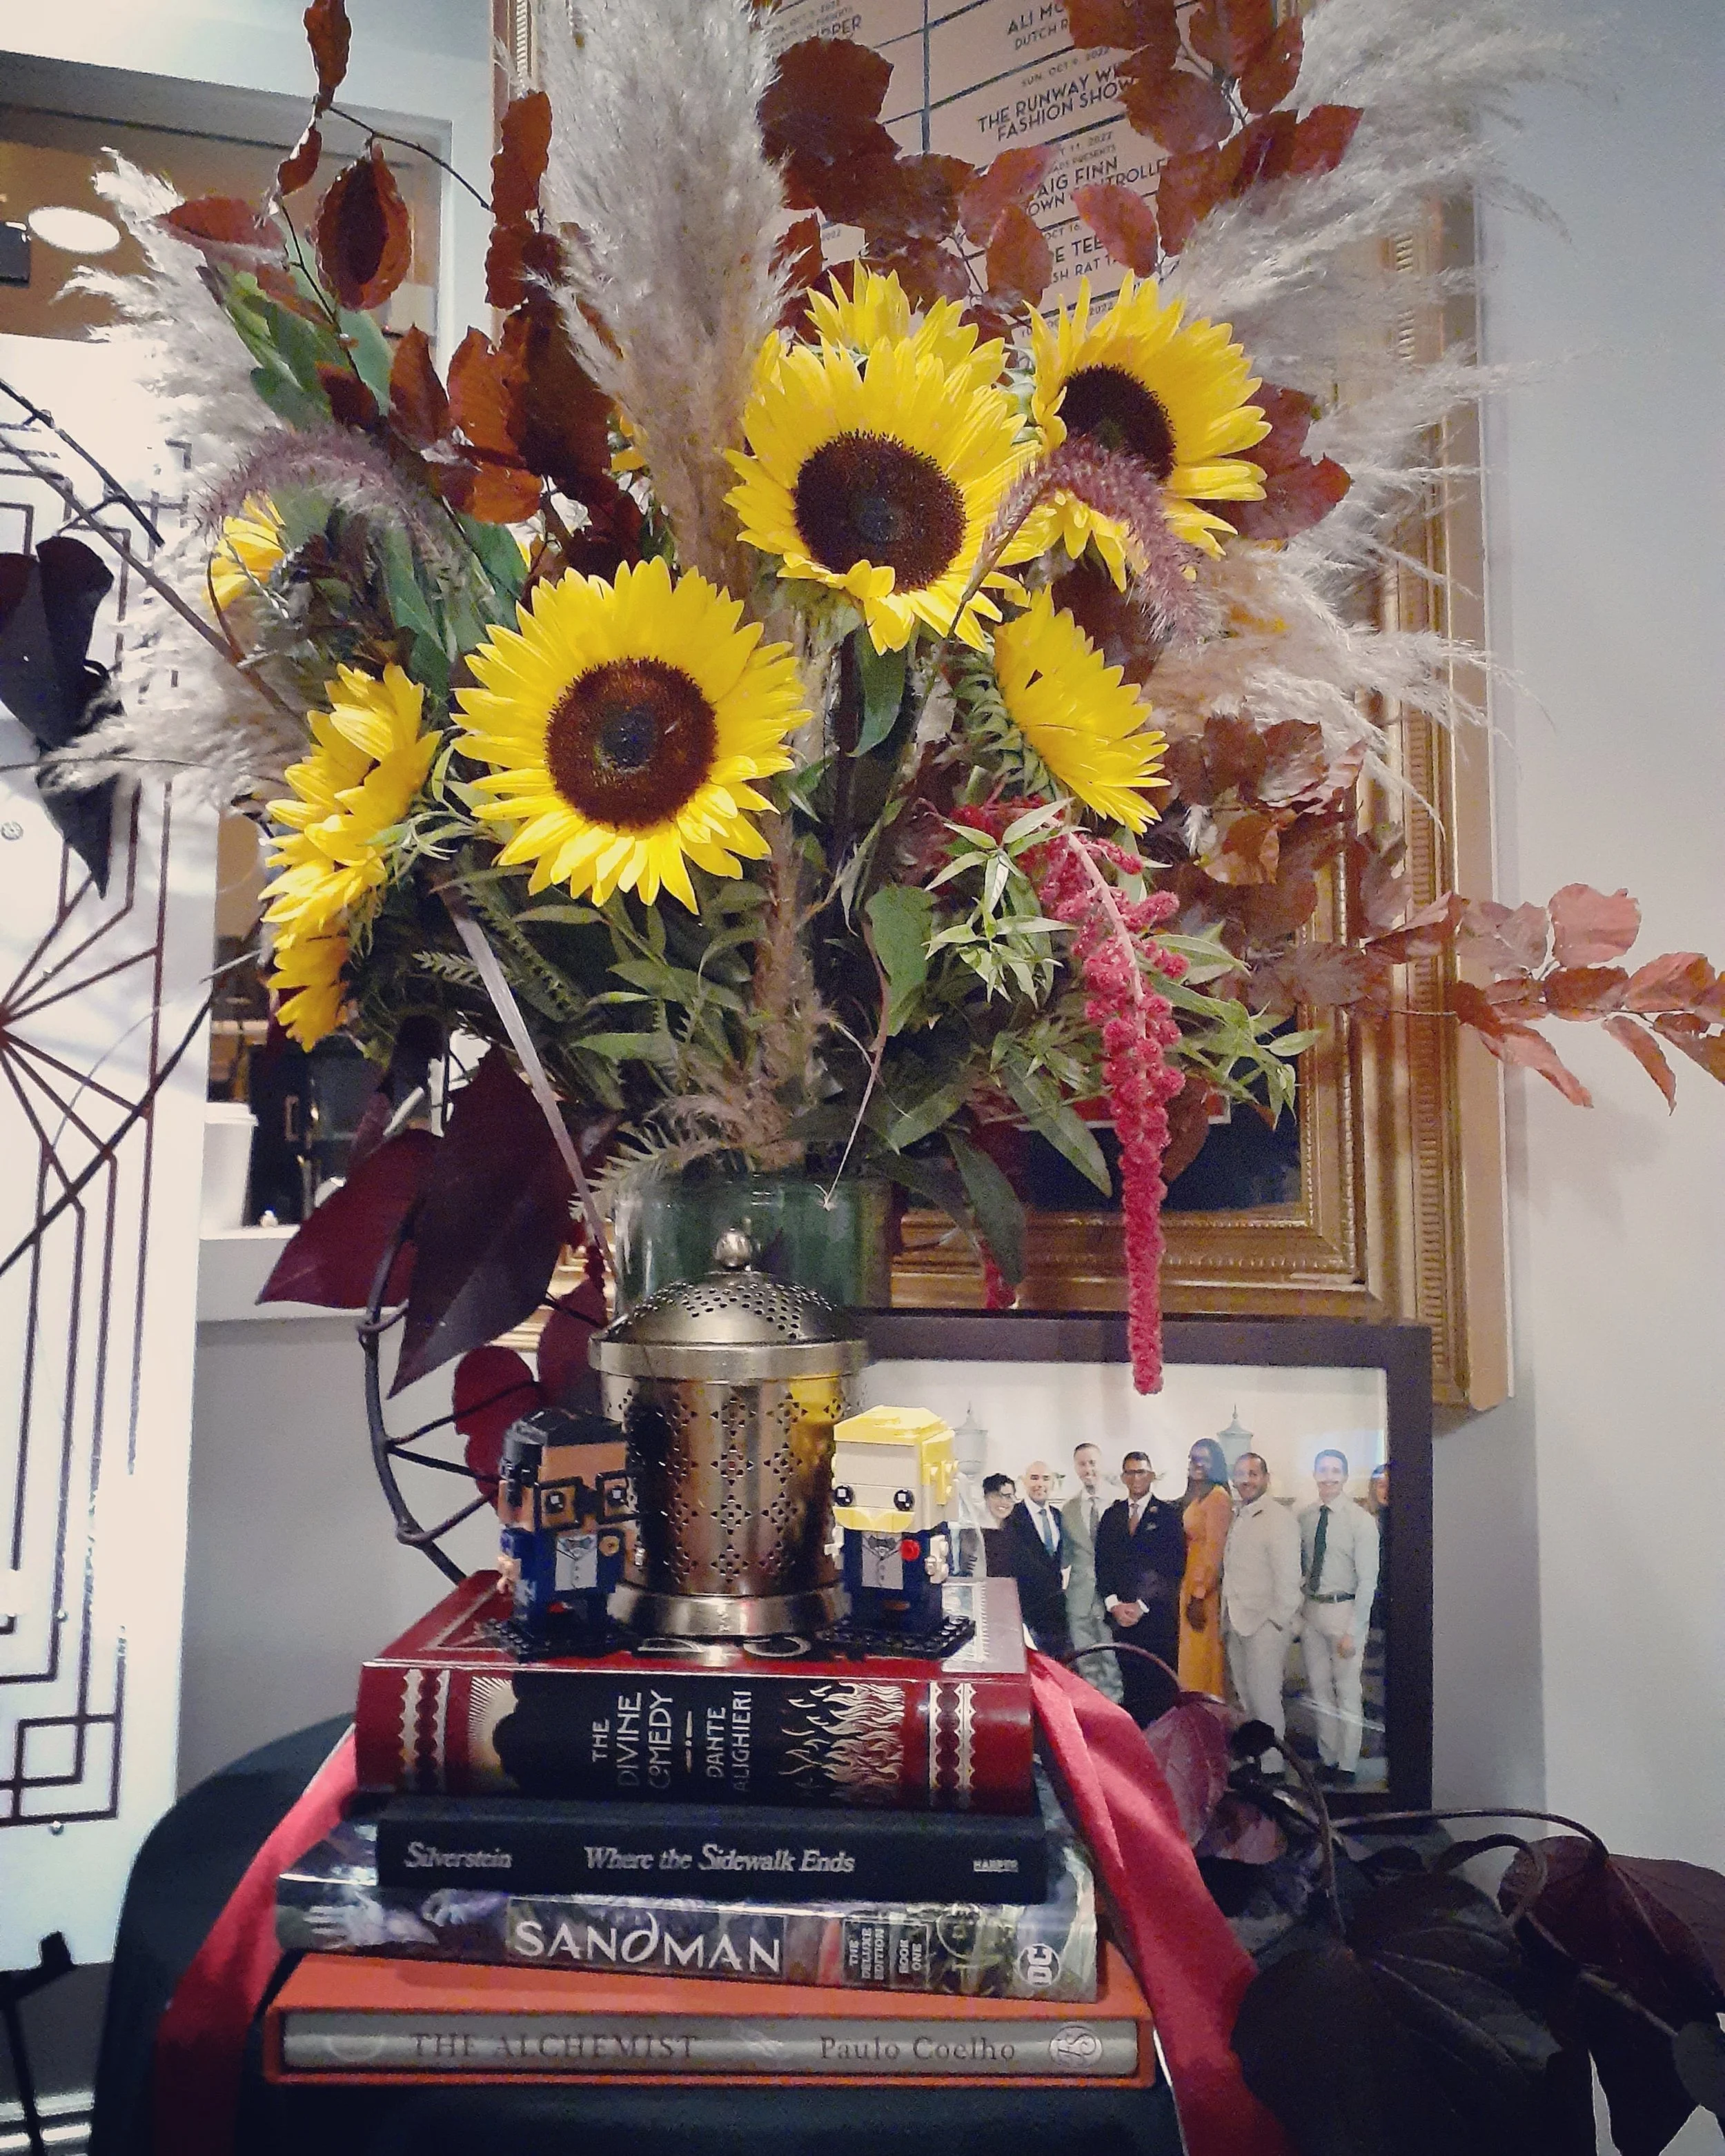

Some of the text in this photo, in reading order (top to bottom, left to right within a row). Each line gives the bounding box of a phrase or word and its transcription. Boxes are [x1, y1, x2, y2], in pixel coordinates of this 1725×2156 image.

[1007, 10, 1033, 34] ALI
[1015, 23, 1057, 50] DUTCH
[978, 106, 1010, 133] THE
[1016, 73, 1089, 117] RUNWAY
[997, 76, 1135, 141] FASHION SHOW
[1036, 156, 1118, 199] AIG FINN
[1027, 192, 1065, 217] OWN
[1072, 235, 1104, 257] TEE
[1053, 268, 1068, 283] SH
[1075, 257, 1100, 276] RAT
[592, 1717, 610, 1762] THE
[616, 1692, 642, 1786] DIVINE
[648, 1690, 673, 1789] COMEDY
[706, 1707, 726, 1778] DANTE
[731, 1690, 752, 1792] ALIGHIERI
[404, 1841, 513, 1868] Silverstein
[583, 1845, 654, 1870] Where
[658, 1848, 692, 1870] the
[698, 1843, 796, 1872] Sidewalk
[799, 1849, 856, 1872] Ends
[515, 1912, 780, 1972] SANDMAN
[848, 1939, 860, 1966] THE
[862, 1928, 872, 1979] DELUXE
[874, 1928, 885, 1980] EDITION
[899, 1939, 909, 1974] BOOK
[911, 1943, 922, 1971] ONE
[1027, 1944, 1052, 1986] DC
[414, 2033, 698, 2058] THE ALCHEMIST
[820, 2036, 1015, 2062] Paulo Coelho
